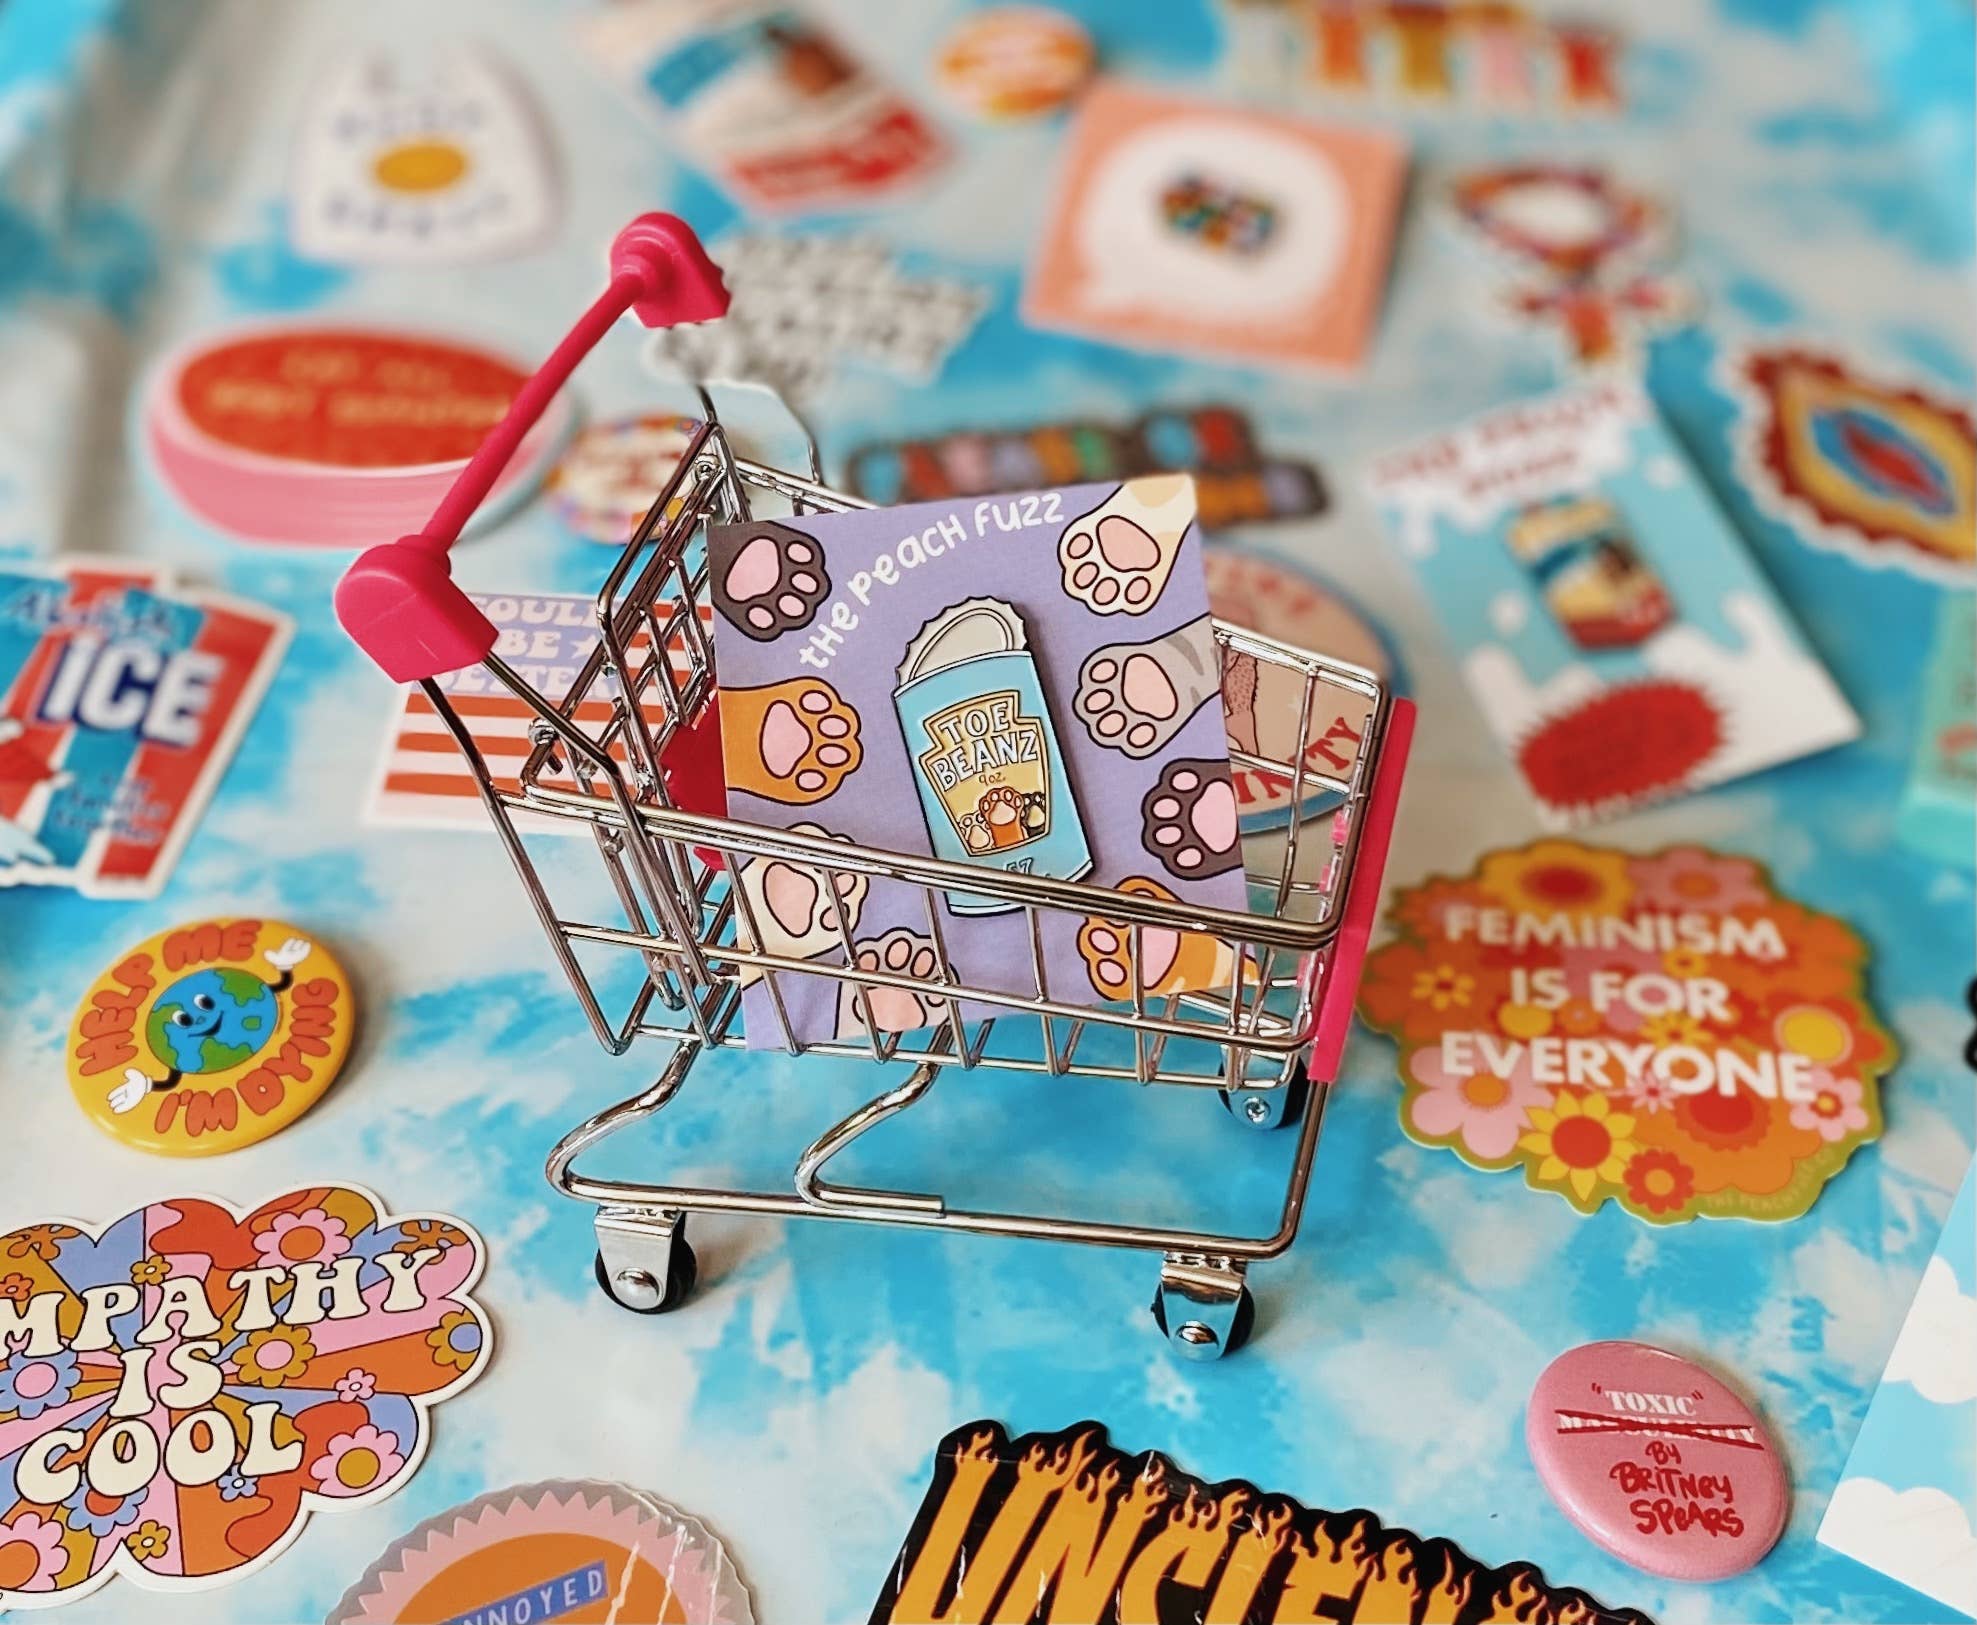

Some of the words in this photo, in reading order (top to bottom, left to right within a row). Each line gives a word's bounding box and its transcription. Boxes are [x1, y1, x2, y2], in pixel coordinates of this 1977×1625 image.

[492, 627, 562, 659] BE
[43, 638, 227, 749] ICE
[937, 701, 1010, 746] TOE
[931, 728, 1039, 793] BEANZ
[1443, 903, 1789, 962] FEMINISM
[75, 952, 157, 1077] HELP
[161, 918, 263, 972] ME
[1510, 966, 1571, 1009] IS
[1590, 970, 1734, 1022] FOR
[153, 1087, 239, 1138] I'M
[236, 977, 340, 1116] DYING
[1440, 1030, 1821, 1102] EVERYONE
[107, 1339, 224, 1418] IS
[14, 1402, 304, 1505] COOL
